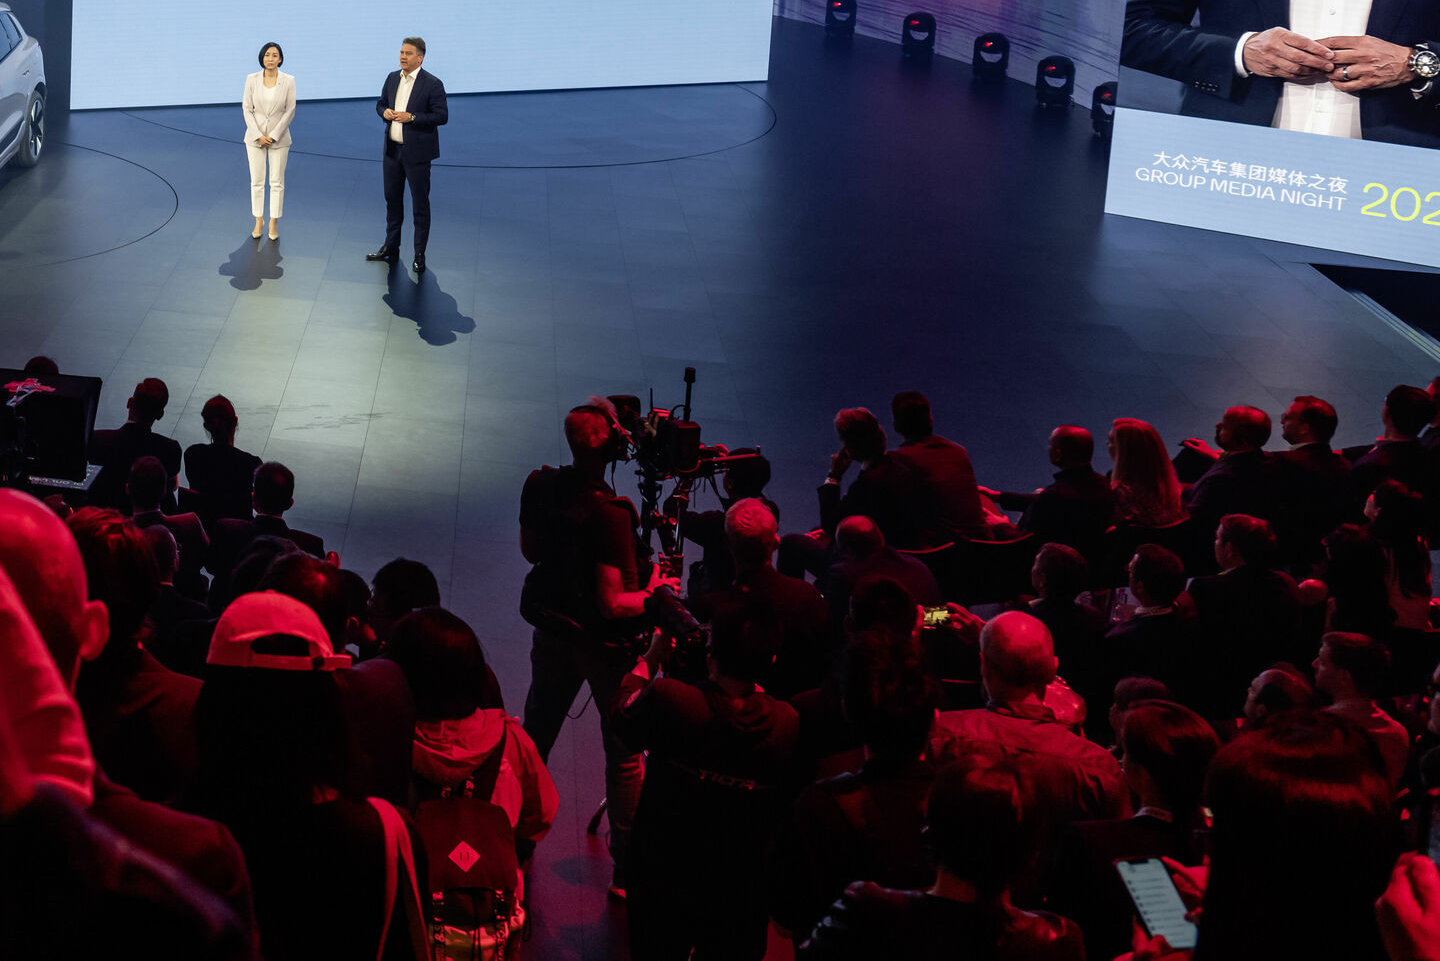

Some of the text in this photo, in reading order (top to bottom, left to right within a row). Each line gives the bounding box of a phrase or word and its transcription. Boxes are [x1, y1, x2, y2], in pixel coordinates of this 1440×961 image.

[1135, 167, 1348, 211] GROUP MEDIA NIGHT
[1152, 150, 1349, 194] 大众汽车集团媒体之夜
